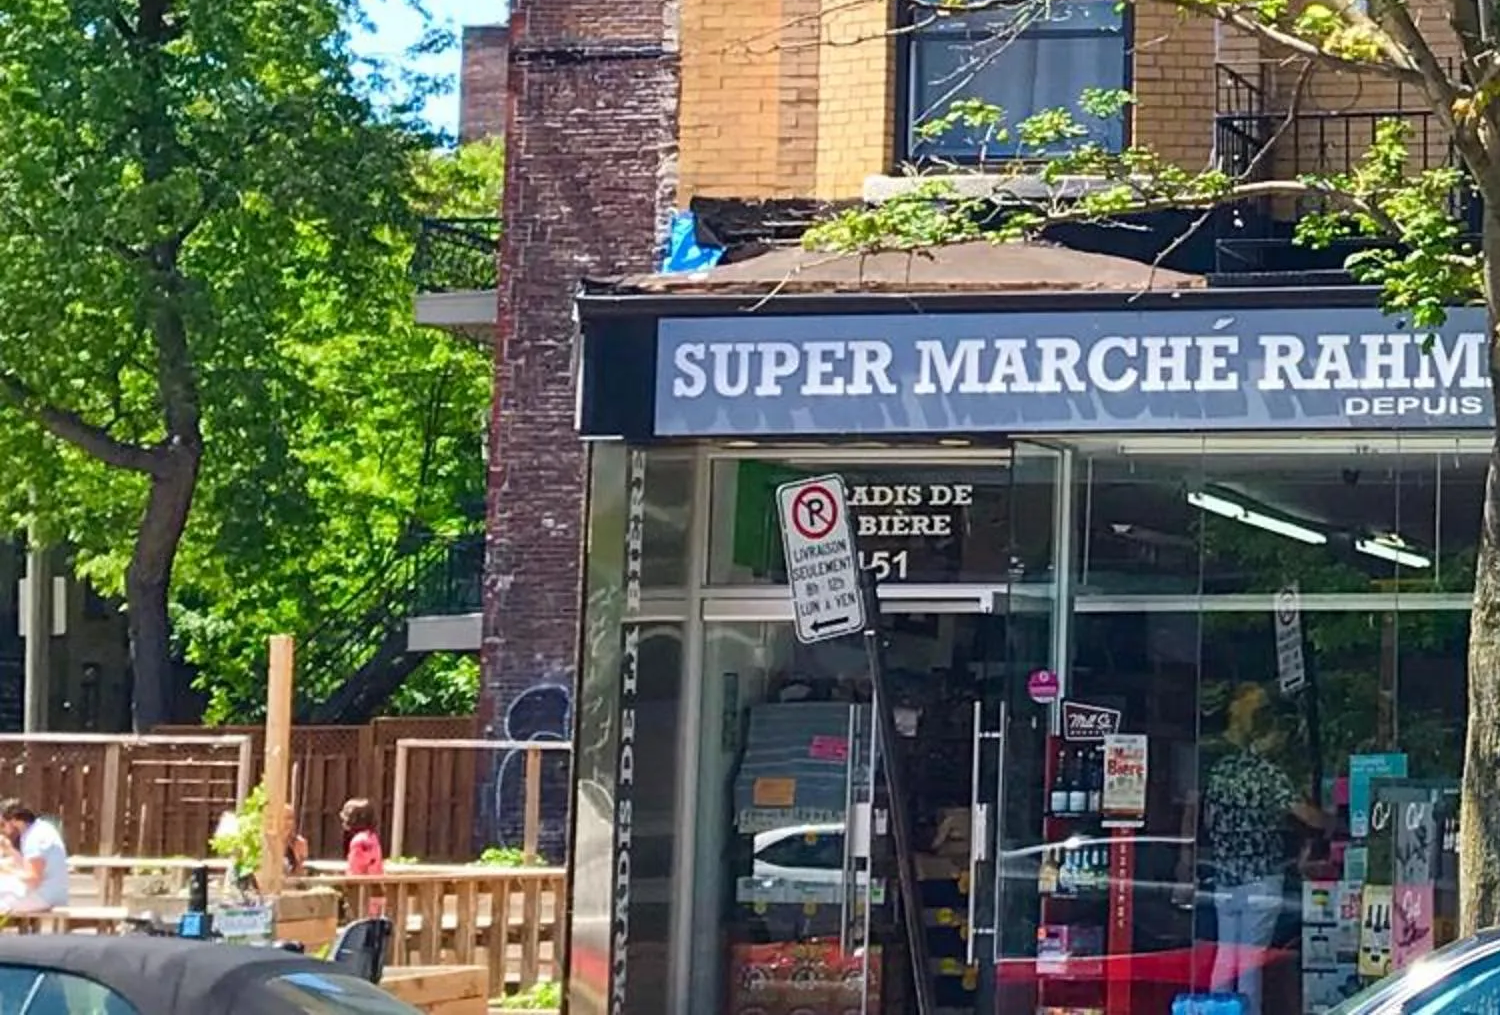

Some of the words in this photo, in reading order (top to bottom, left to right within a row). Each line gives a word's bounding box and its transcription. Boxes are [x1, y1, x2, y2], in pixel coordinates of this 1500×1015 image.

[673, 340, 897, 398] SUPER
[913, 317, 1239, 394] MARCHÉ
[1345, 396, 1483, 416] DEPUIS
[845, 485, 922, 506] ADIS
[929, 485, 973, 506] DE
[858, 509, 951, 536] BIÈRE
[793, 539, 847, 563] LIVRAISON
[791, 555, 851, 582] SEULEMENT
[834, 592, 856, 608] VEN
[623, 625, 639, 695] LA
[620, 709, 635, 784] DE
